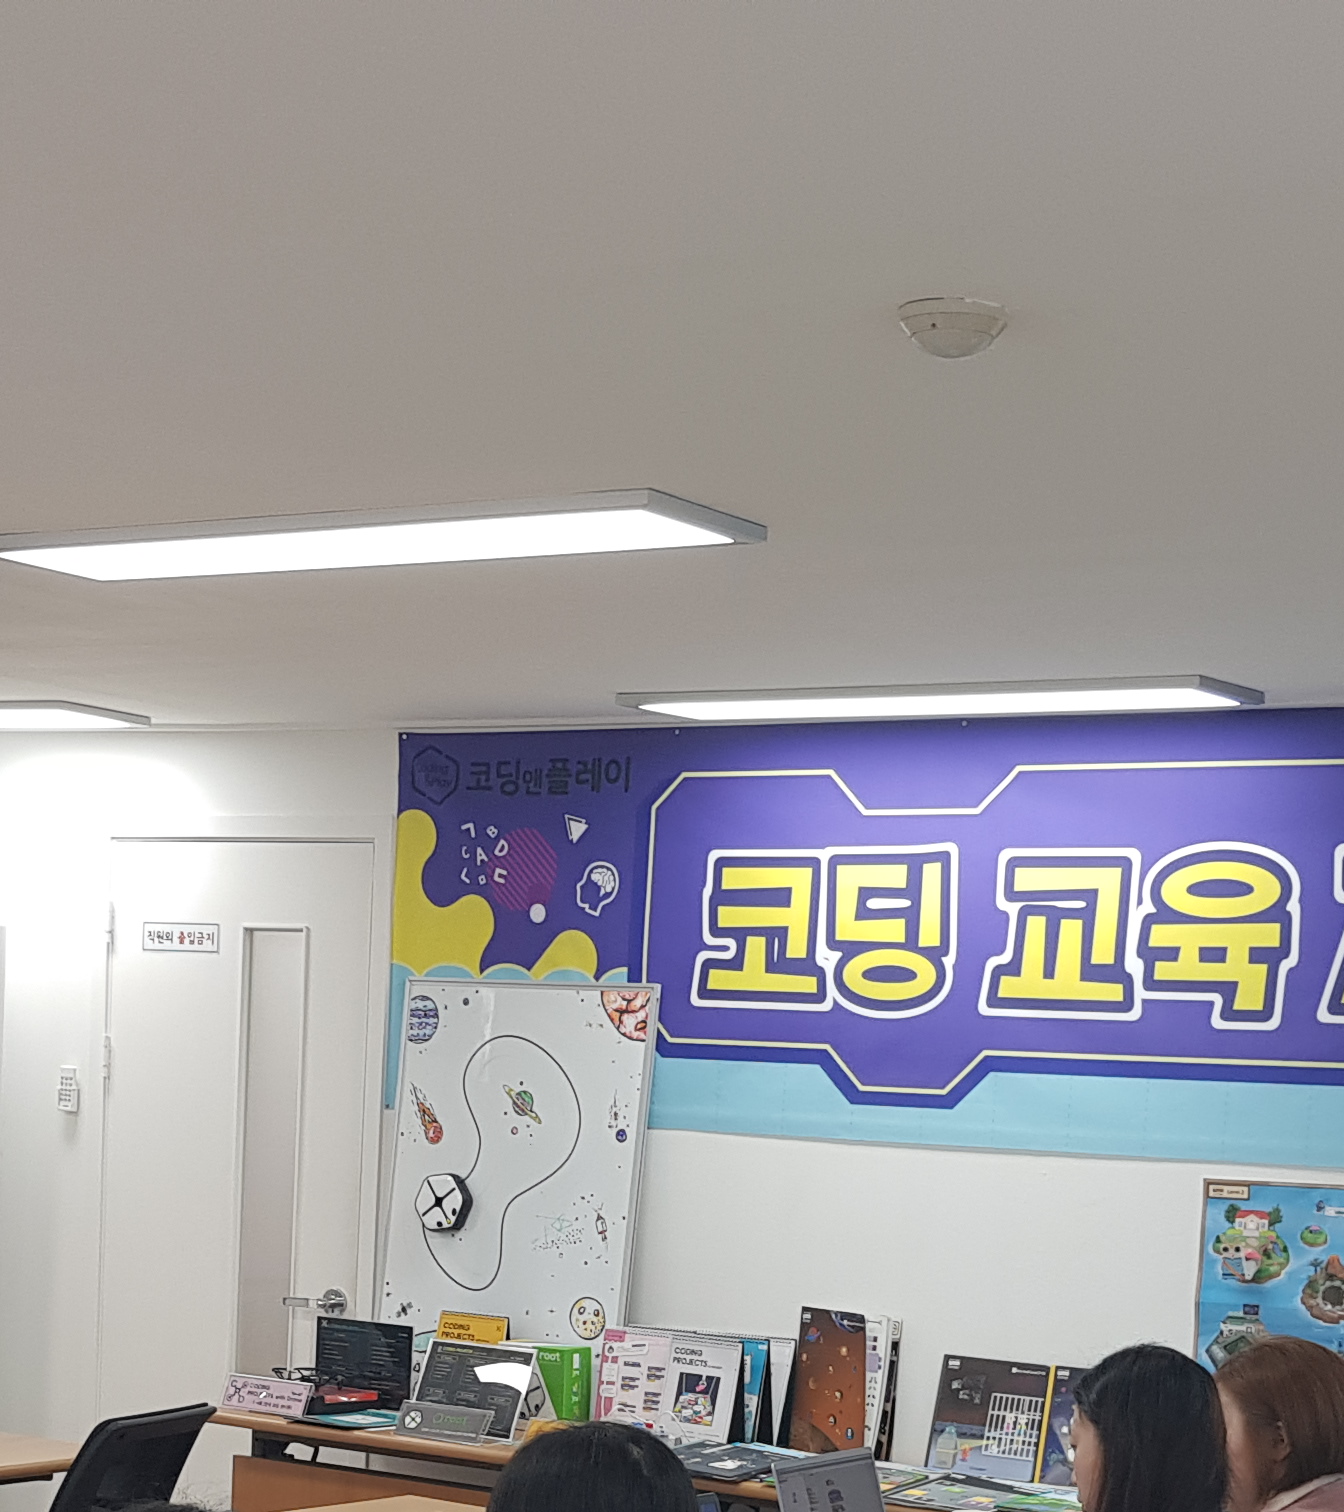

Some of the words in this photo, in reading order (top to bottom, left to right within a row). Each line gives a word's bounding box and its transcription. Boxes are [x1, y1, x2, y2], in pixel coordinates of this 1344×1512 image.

[465, 756, 632, 797] 코딩앤플레이
[176, 930, 215, 946] 출입금지
[690, 842, 959, 1020] 코딩
[978, 841, 1301, 1031] 교육
[538, 1351, 561, 1362] root
[674, 1346, 703, 1356] CODING
[672, 1356, 708, 1368] PROJECTS
